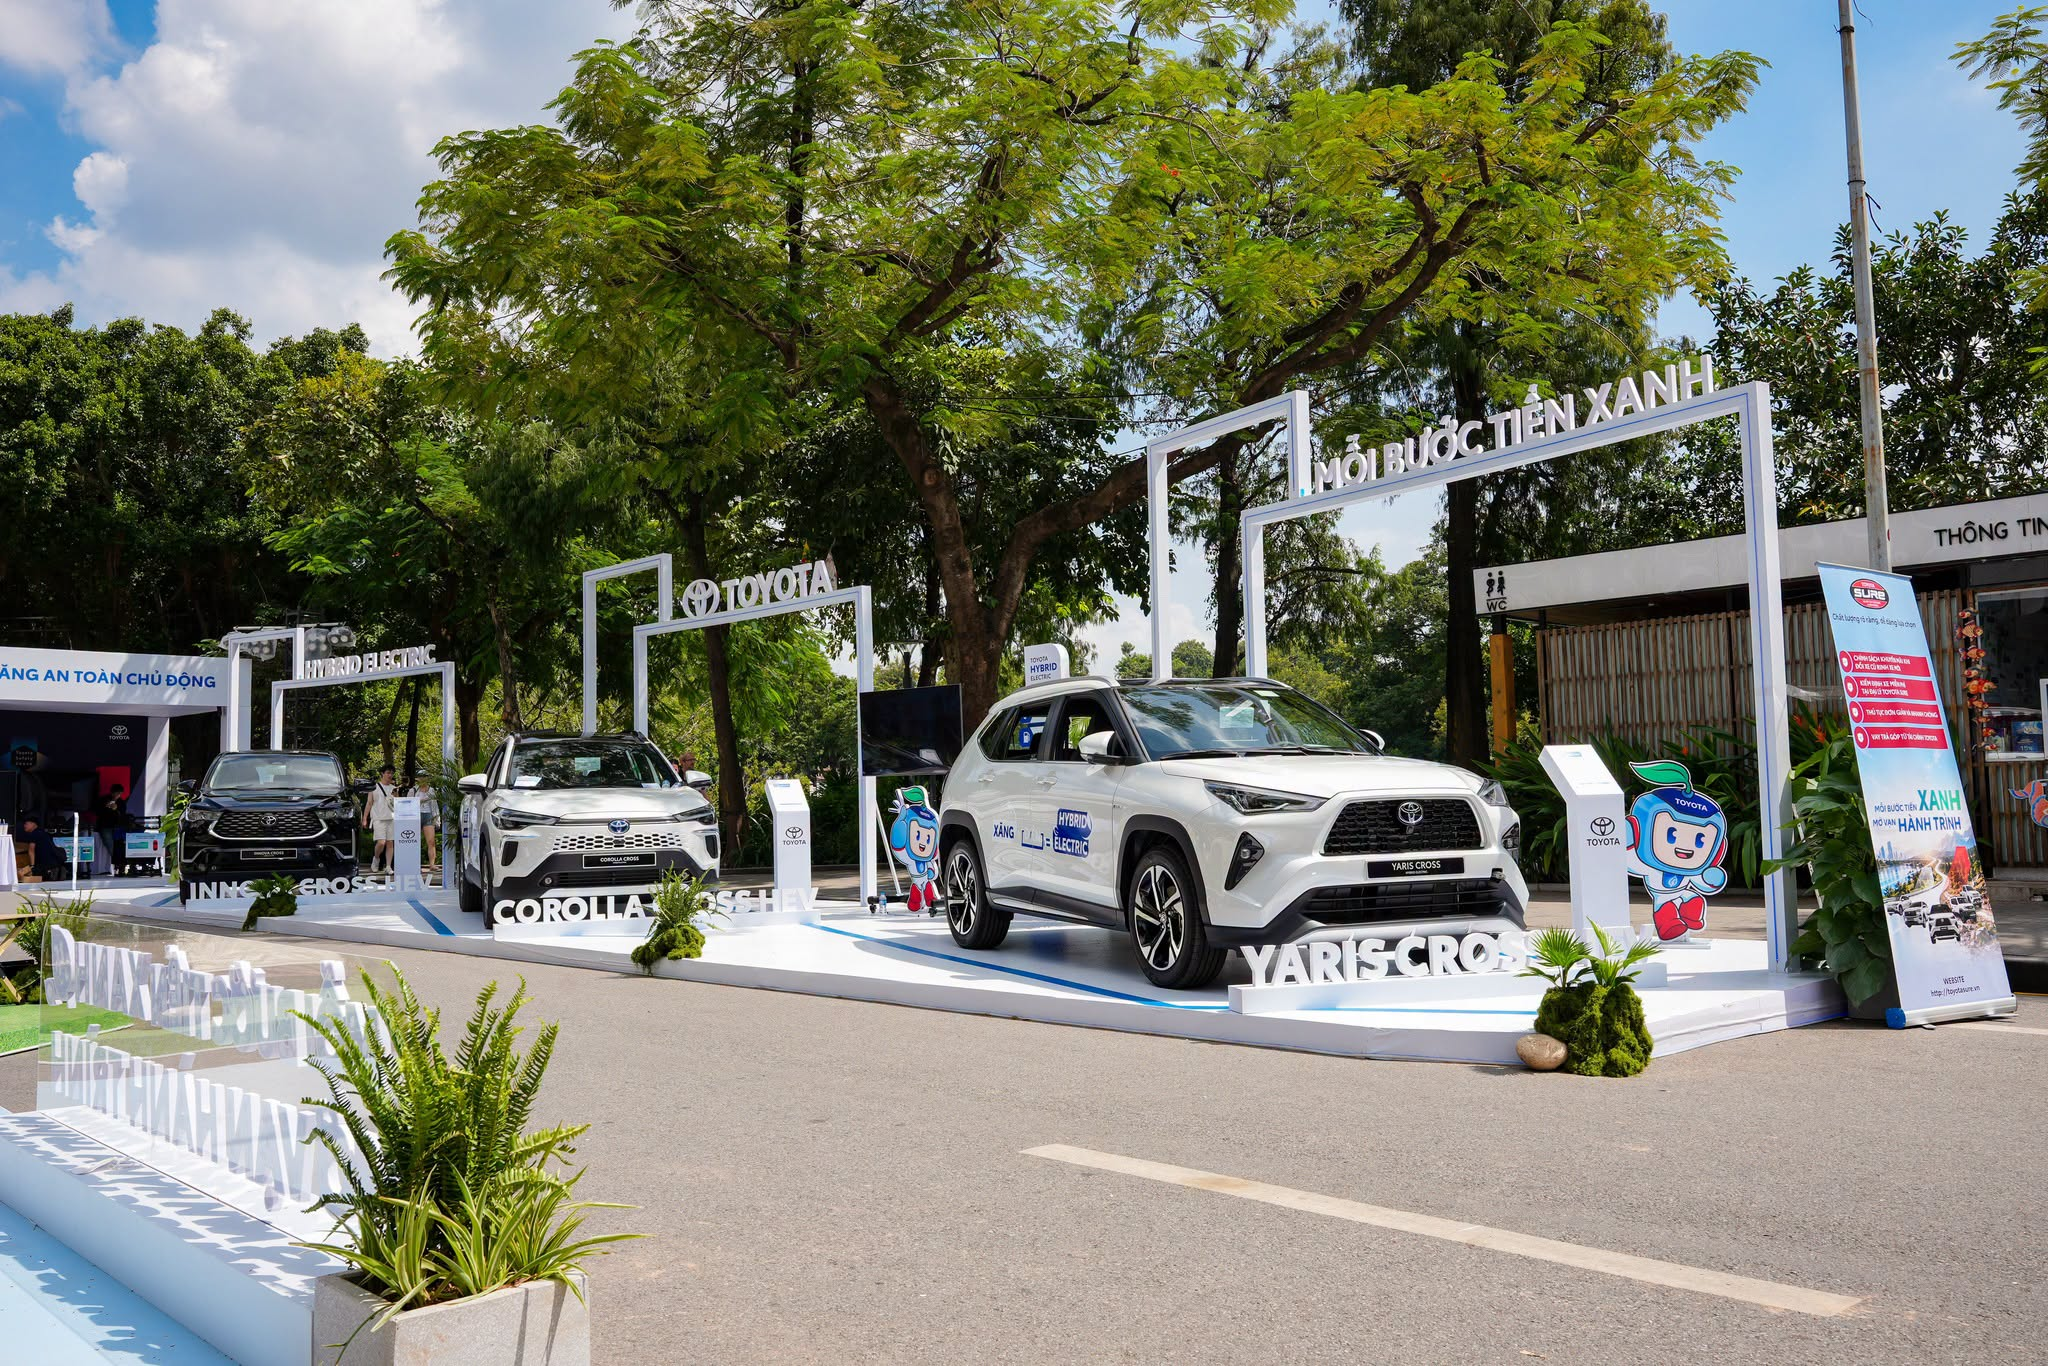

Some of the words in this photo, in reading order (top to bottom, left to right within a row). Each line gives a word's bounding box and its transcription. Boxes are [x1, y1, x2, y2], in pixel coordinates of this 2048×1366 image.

[1314, 433, 1377, 494] MỖI
[1384, 415, 1484, 477] BƯỚC
[1583, 354, 1714, 427] XANH
[1933, 520, 2008, 546] THÔNG
[721, 560, 834, 611] TOYOTA
[1486, 600, 1507, 611] WC
[304, 655, 361, 679] HYBRID
[363, 644, 436, 673] ELECTRIC
[1030, 663, 1057, 673] HYBRID
[43, 670, 69, 683] AN
[74, 667, 122, 685] TOÀN
[126, 670, 162, 686] CHỦ
[166, 672, 216, 690] ĐỘNG
[1030, 673, 1051, 681] ELECTRIC
[1675, 798, 1708, 812] TOYOTA
[1917, 789, 1961, 811] XANH
[1058, 811, 1088, 828] HYBRID
[1898, 814, 1931, 832] HÀNH
[1933, 813, 1961, 830] TRÌNH
[993, 822, 1014, 839] XĂNG
[1054, 838, 1088, 855] ELECTRIC
[1586, 838, 1620, 846] TOYOTA
[1392, 861, 1414, 871] YARIS
[1415, 860, 1441, 870] CROSS
[299, 876, 377, 896] CROSS
[384, 874, 432, 893] HEV
[492, 894, 647, 925] COROLLA
[759, 887, 819, 913] HEV
[1240, 938, 1386, 988] YARIS
[1943, 976, 1965, 985] WEBSITE
[1931, 985, 1981, 997] http://toyotasure.vn
